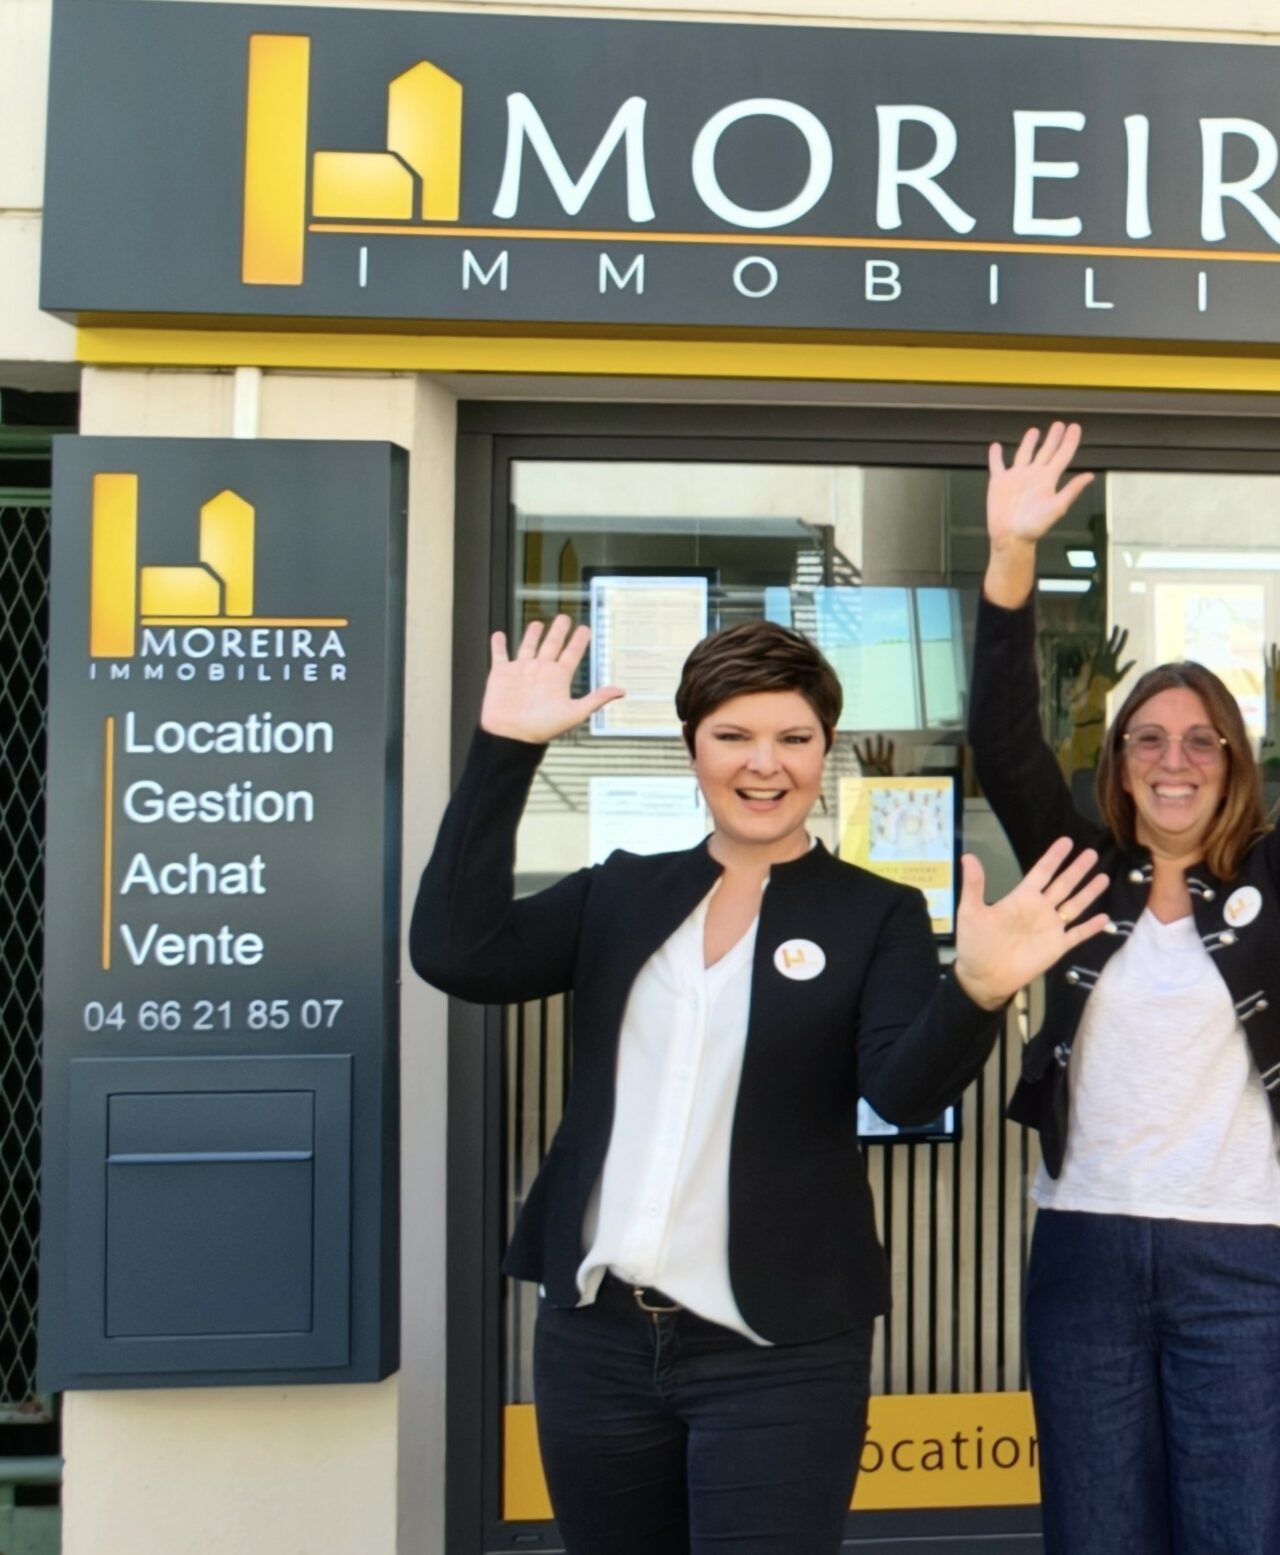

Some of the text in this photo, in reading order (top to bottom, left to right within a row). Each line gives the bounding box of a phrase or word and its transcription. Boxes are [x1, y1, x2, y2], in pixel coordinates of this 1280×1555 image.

[140, 628, 347, 659] MOREIRA
[89, 663, 348, 682] IMMOBILIER
[124, 711, 335, 754] Location
[122, 780, 315, 824] Gestion
[119, 852, 267, 896] Achat
[119, 922, 265, 966] Vente
[83, 999, 344, 1032] 04 66 21 85 07
